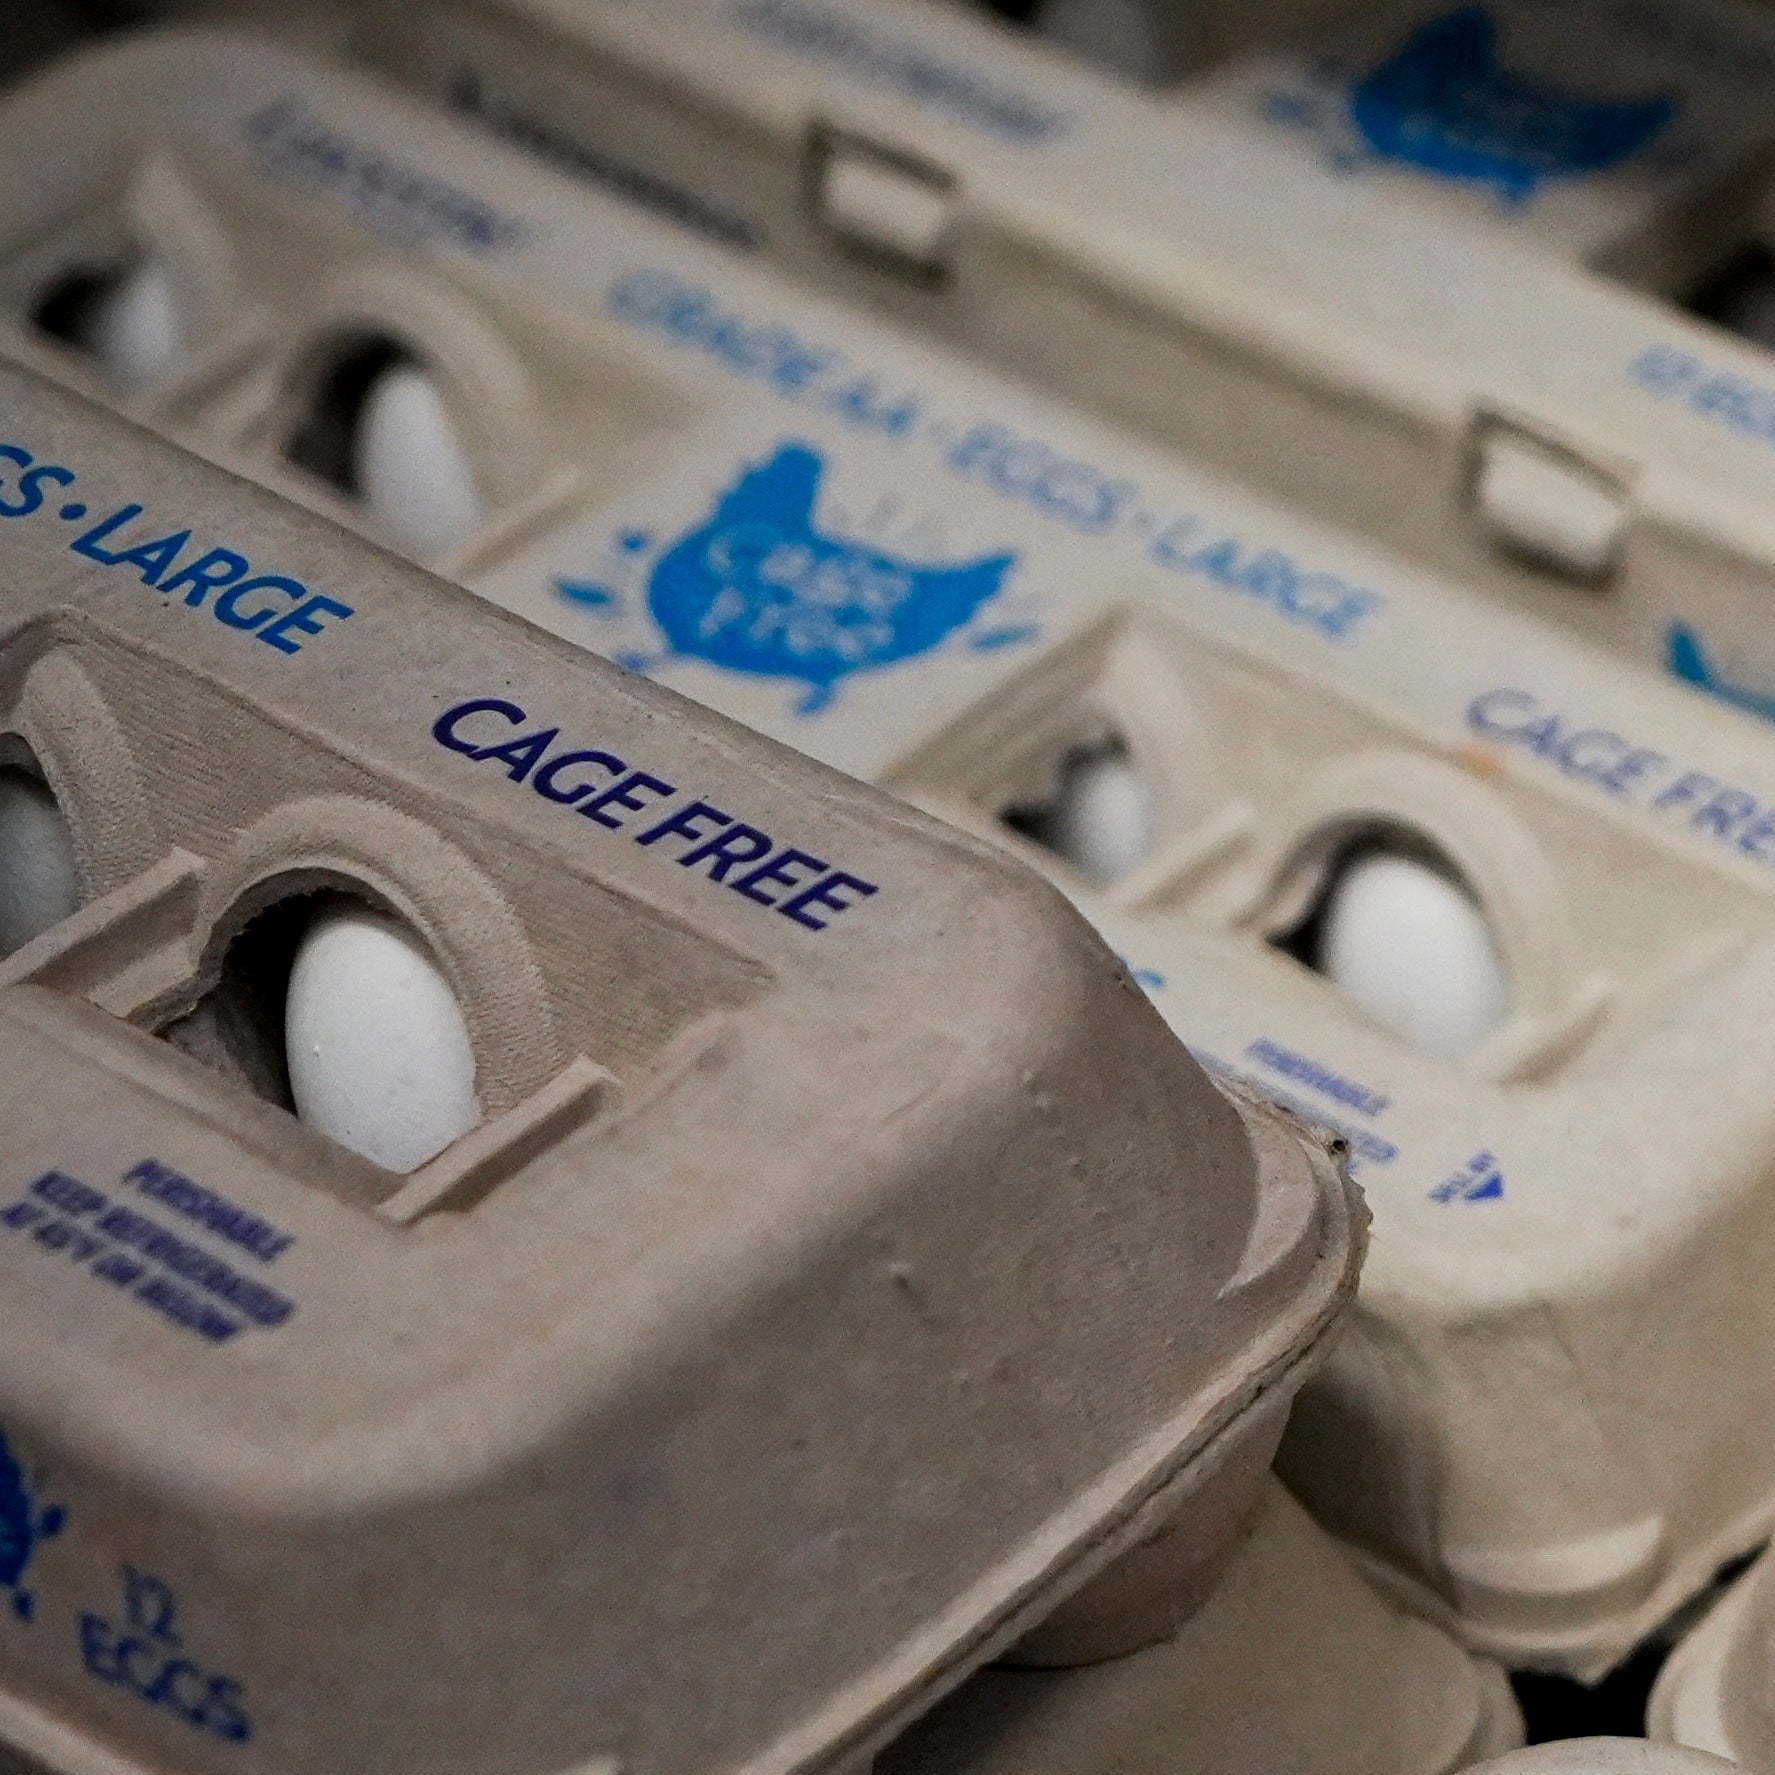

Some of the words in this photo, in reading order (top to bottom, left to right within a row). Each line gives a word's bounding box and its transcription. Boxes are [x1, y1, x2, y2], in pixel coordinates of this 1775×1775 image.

[68, 502, 356, 656] LARGE
[432, 696, 677, 832] CAGE
[634, 798, 881, 933] FREE
[1462, 686, 1668, 799] CAGE
